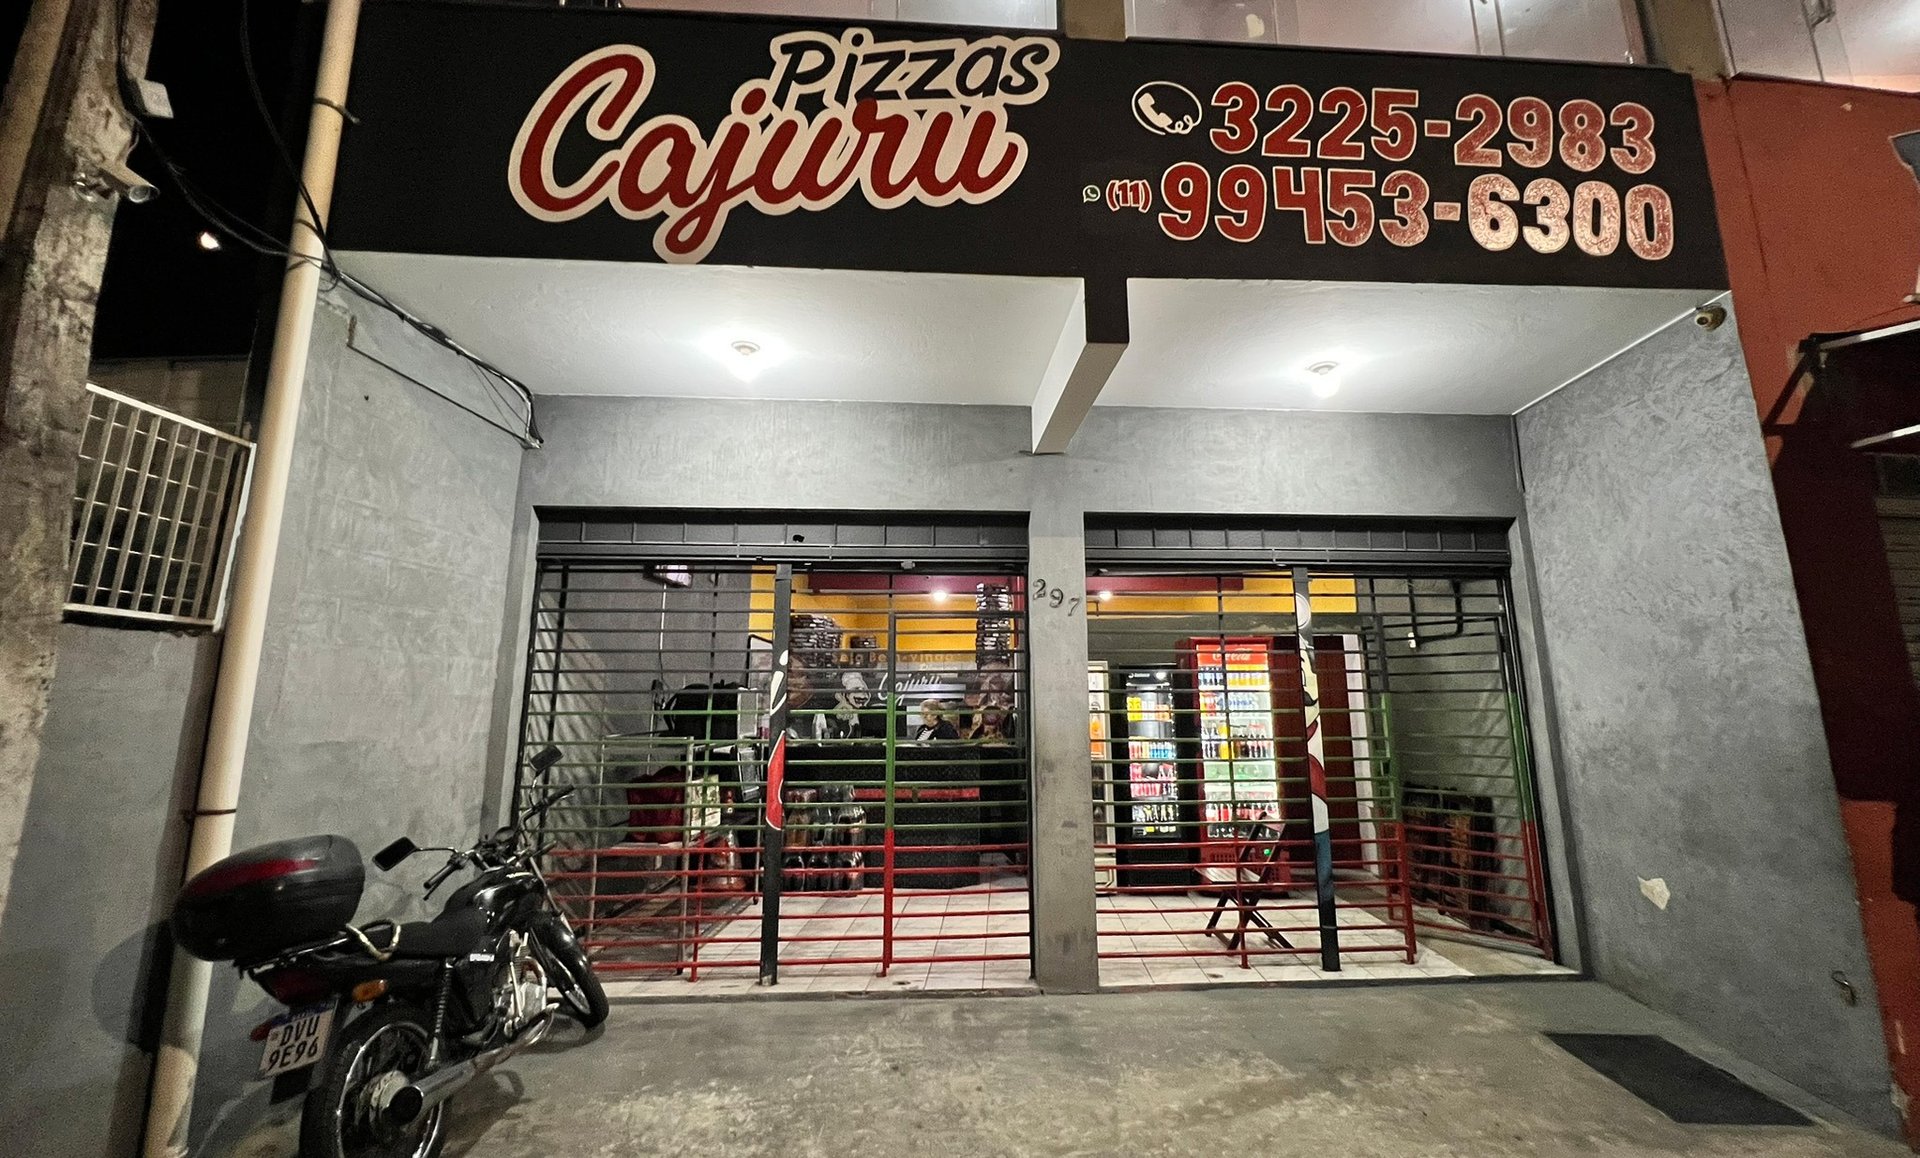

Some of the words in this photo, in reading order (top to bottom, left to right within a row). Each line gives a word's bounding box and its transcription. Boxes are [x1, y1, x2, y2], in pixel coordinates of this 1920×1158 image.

[768, 30, 1051, 106] Pizzas
[516, 52, 1020, 256] Cajuru
[1209, 80, 1657, 175] 3225-2983
[1105, 179, 1153, 213] (11)
[1157, 161, 1675, 261] 99453-6300
[1032, 578, 1082, 617] 297
[267, 1036, 320, 1073] 9E96
[279, 1014, 321, 1048] DVU
